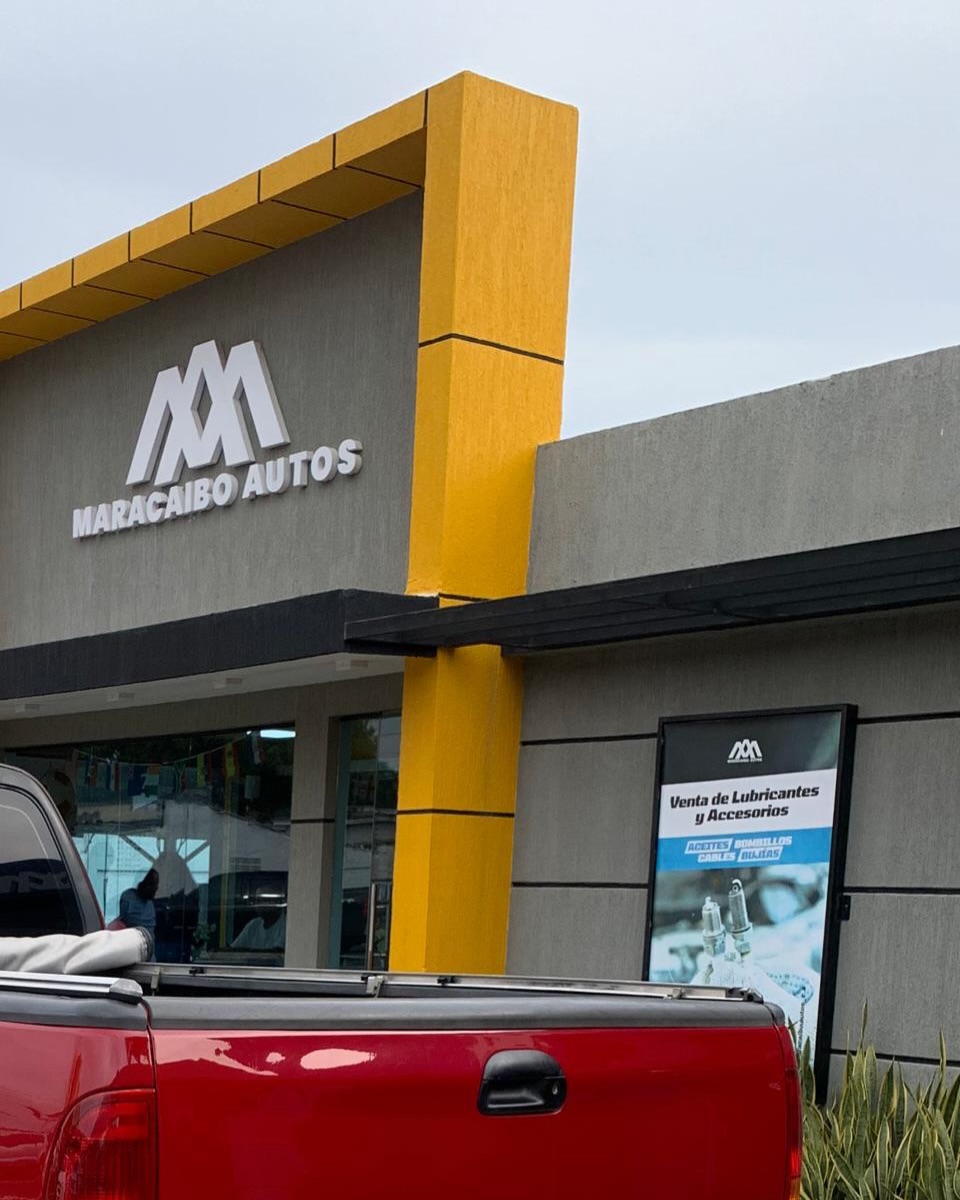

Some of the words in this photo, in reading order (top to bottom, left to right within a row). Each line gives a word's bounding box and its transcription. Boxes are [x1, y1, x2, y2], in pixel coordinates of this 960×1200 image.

[73, 473, 239, 538] MARACAIBO
[242, 439, 363, 499] AUTOS
[670, 796, 709, 809] Venta
[711, 792, 729, 806] de
[732, 785, 820, 804] Lubricantes
[695, 813, 705, 825] y
[707, 805, 789, 822] Accesorios
[687, 841, 729, 852] ACEITES
